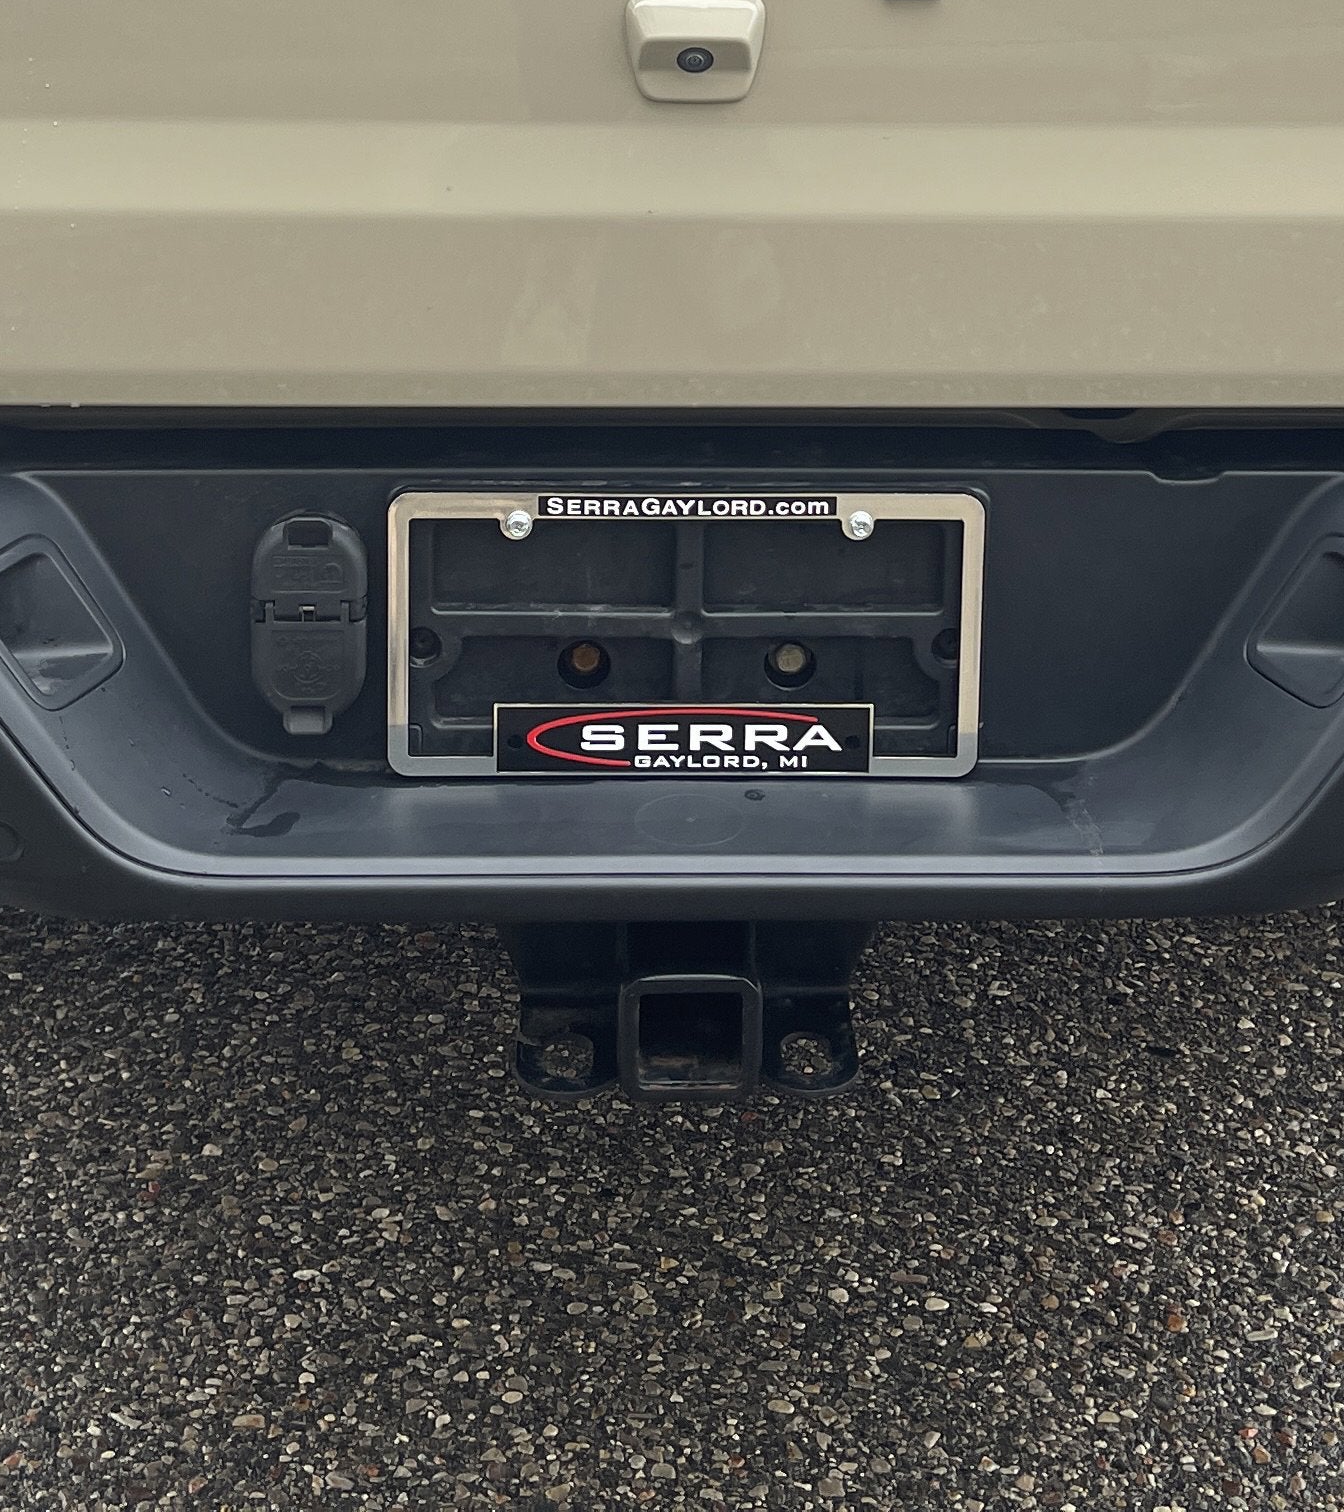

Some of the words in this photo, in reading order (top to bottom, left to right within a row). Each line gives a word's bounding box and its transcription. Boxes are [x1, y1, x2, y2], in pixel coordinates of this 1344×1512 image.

[545, 495, 831, 517] SERRAGAYLORD.com
[579, 723, 844, 752] SERRA
[633, 754, 769, 770] GAYLORD,
[778, 755, 809, 769] MI
